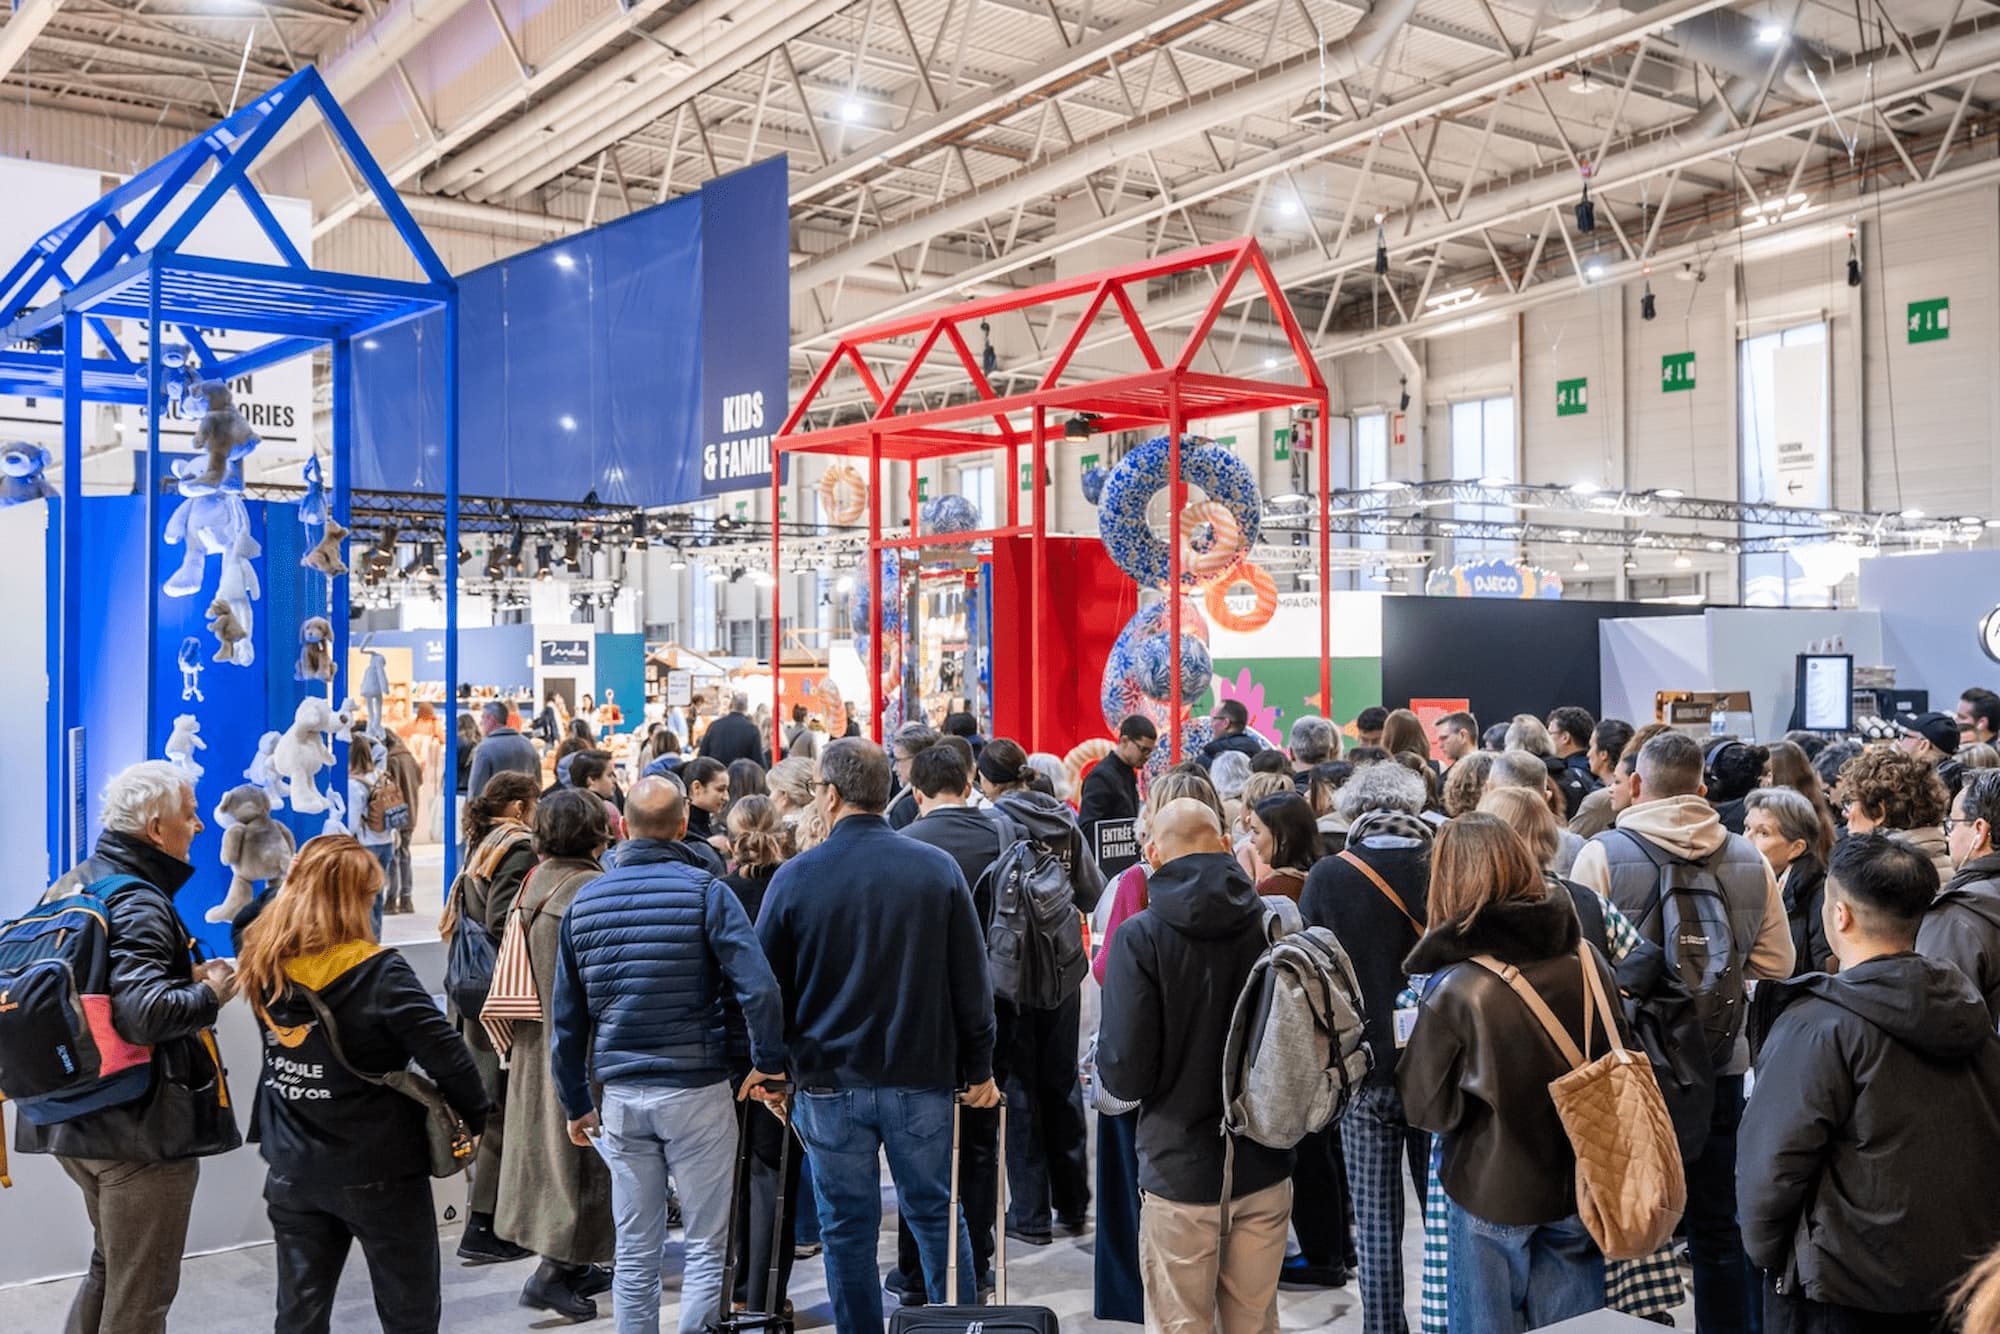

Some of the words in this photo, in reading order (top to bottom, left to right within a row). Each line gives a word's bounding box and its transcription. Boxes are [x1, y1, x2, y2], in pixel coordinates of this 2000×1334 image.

[722, 390, 764, 434] KIDS
[704, 443, 717, 481] &
[720, 434, 774, 479] FAMIL
[1474, 575, 1518, 593] DJECO
[1102, 824, 1132, 842] ENTRÉE
[1102, 842, 1137, 859] ENTRANCE
